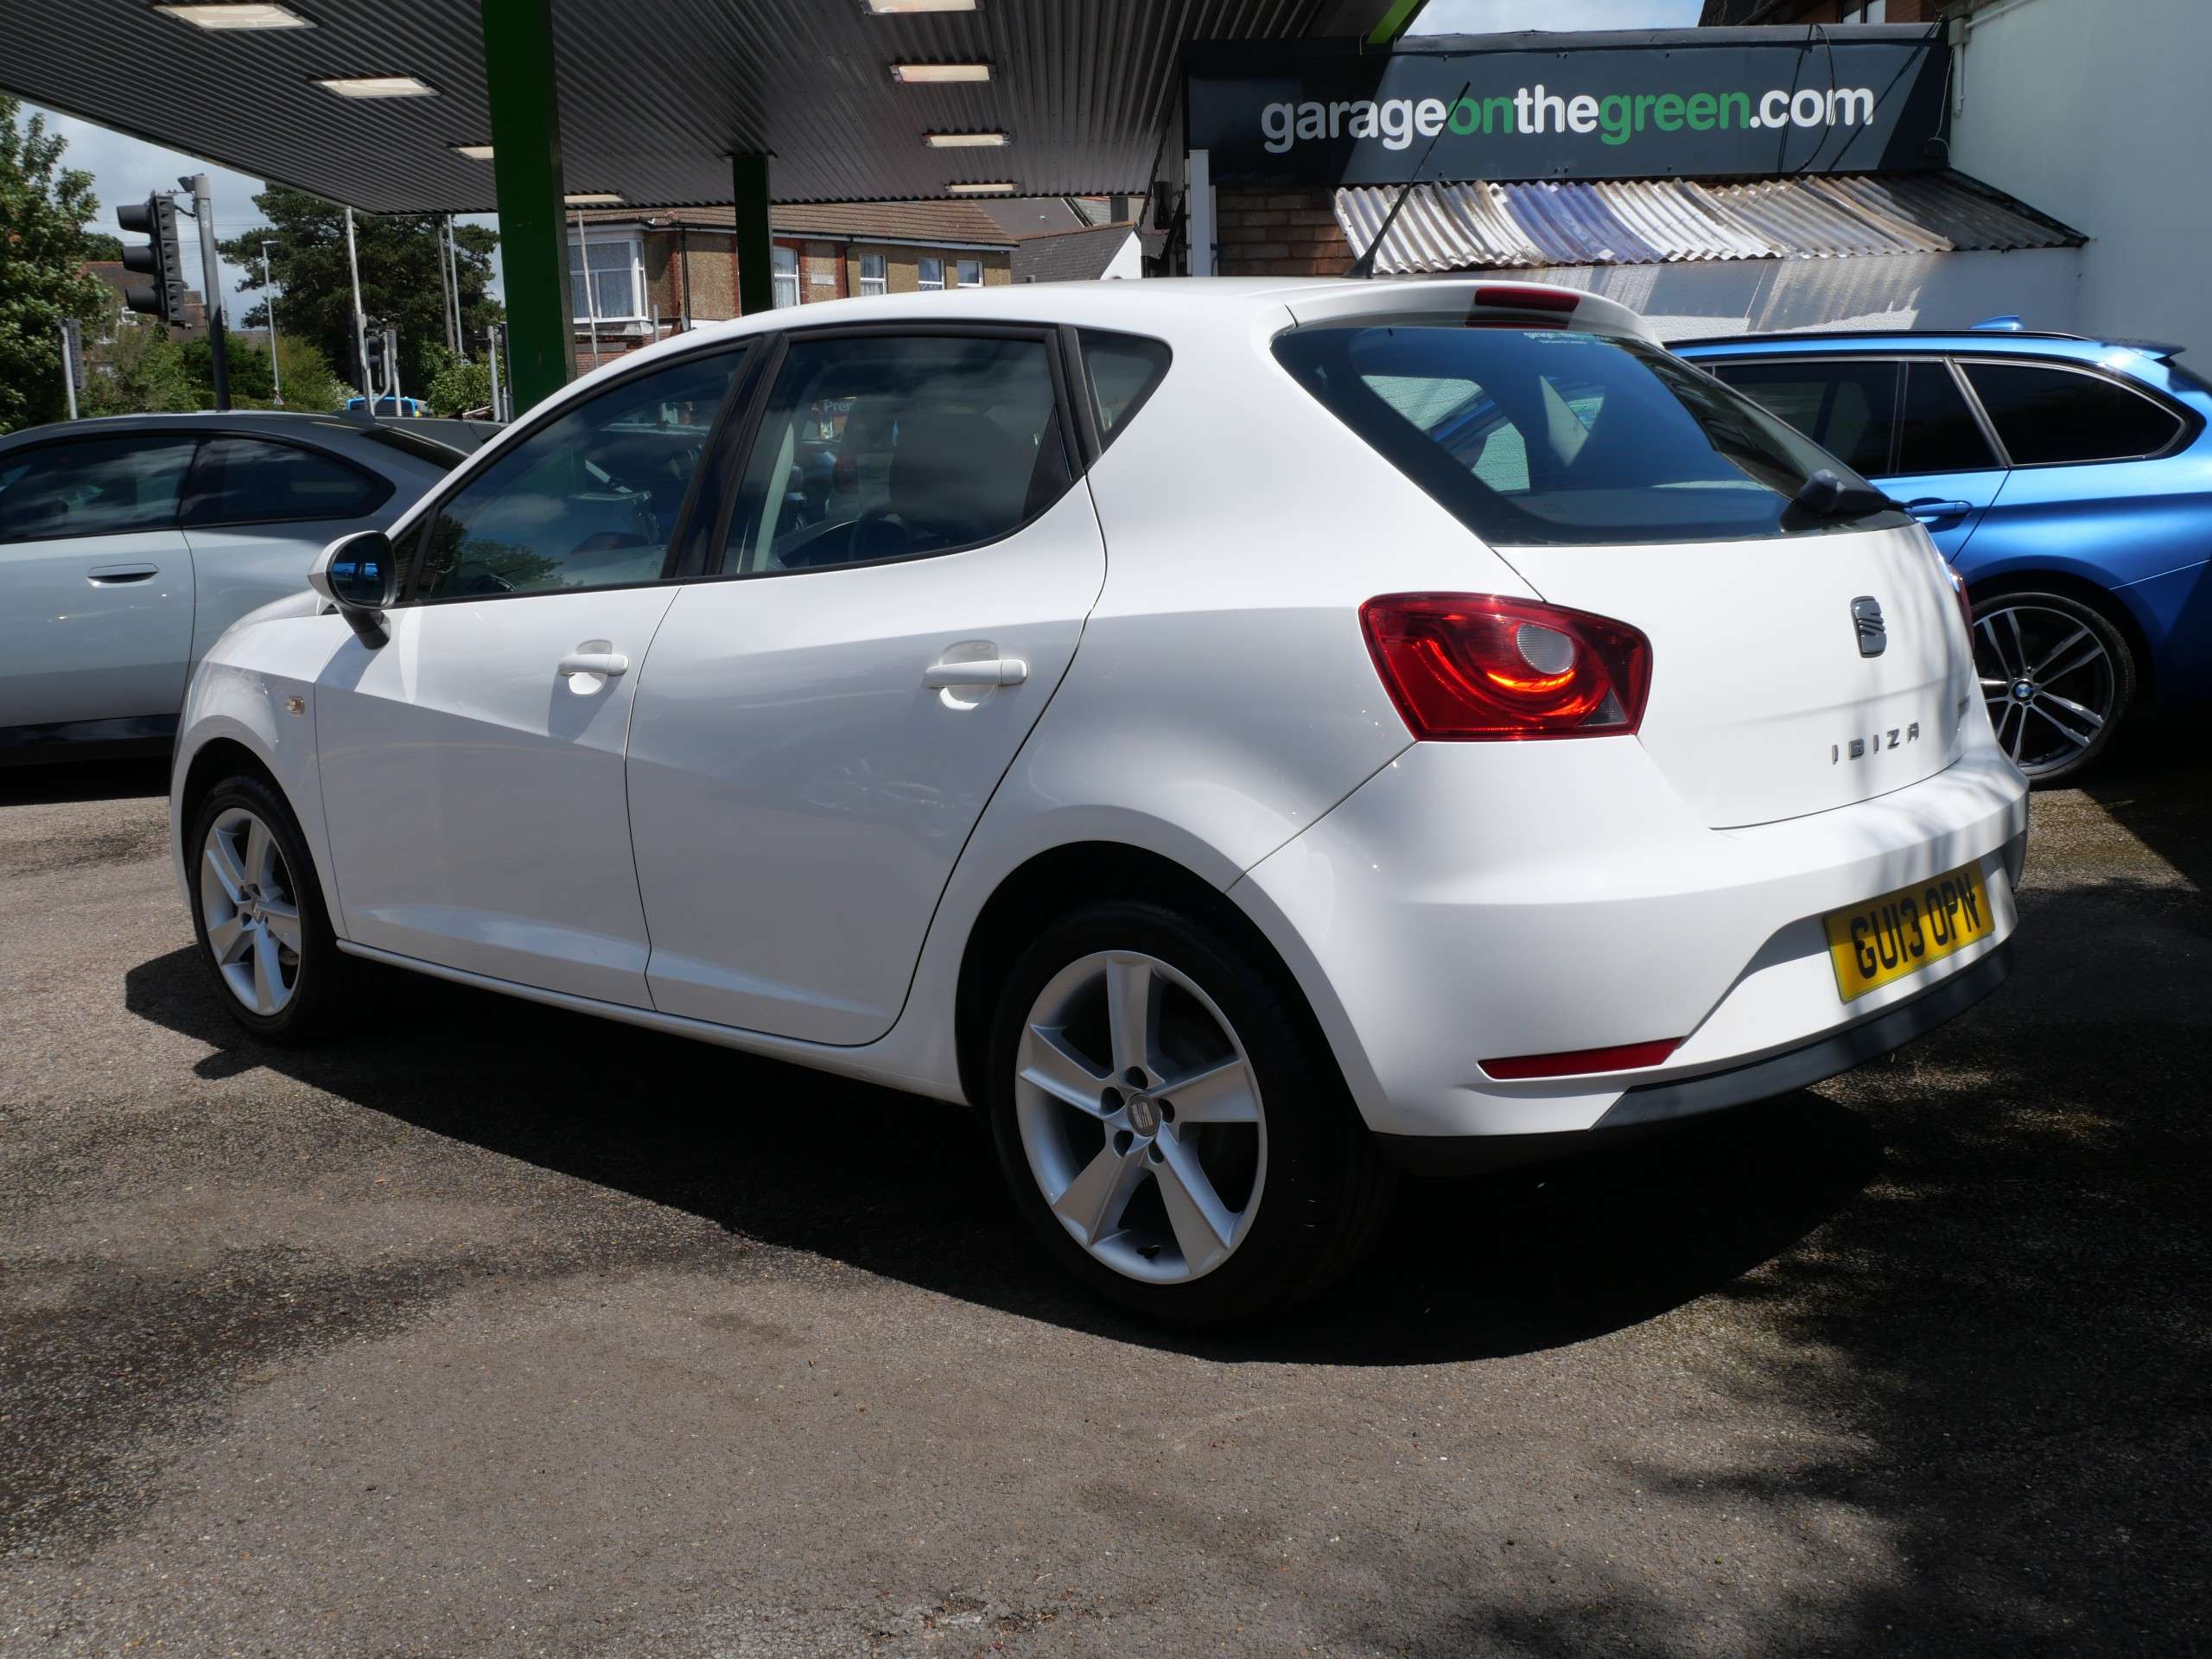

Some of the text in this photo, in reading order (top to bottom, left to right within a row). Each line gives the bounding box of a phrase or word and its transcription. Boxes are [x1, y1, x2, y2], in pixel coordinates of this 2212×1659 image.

[1261, 84, 1874, 153] garageonthegreen.com
[1831, 721, 1920, 765] IBIZA
[1850, 873, 1980, 980] GU13 OPN
